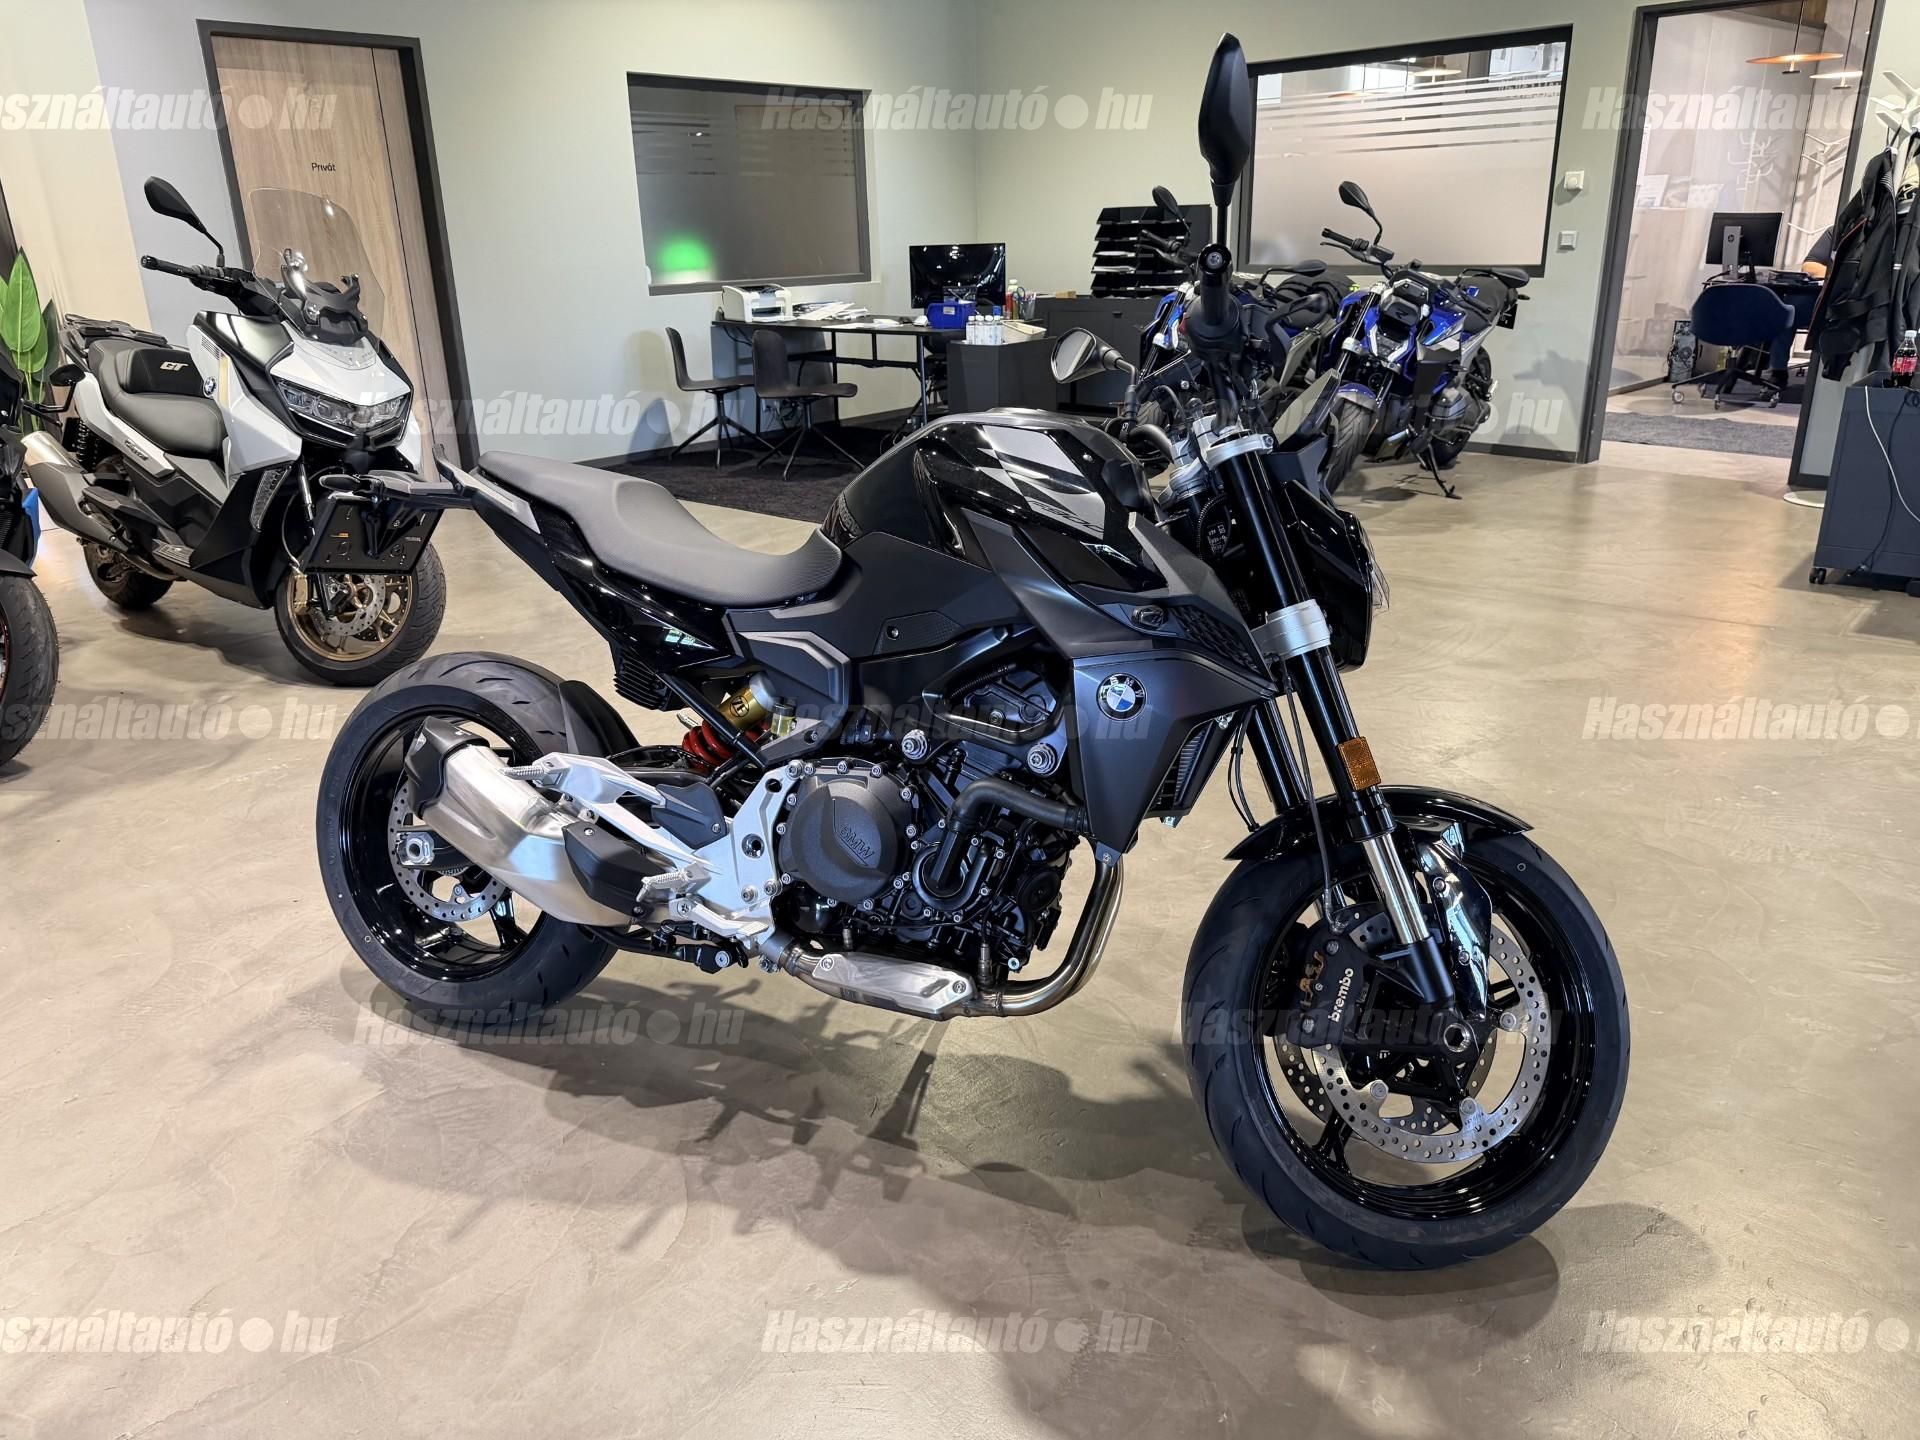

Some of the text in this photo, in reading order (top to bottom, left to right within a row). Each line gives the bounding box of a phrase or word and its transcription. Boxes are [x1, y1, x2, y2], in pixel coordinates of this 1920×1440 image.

[160, 361, 189, 371] GT
[840, 826, 875, 860] BMW
[1328, 968, 1354, 1022] brembo
